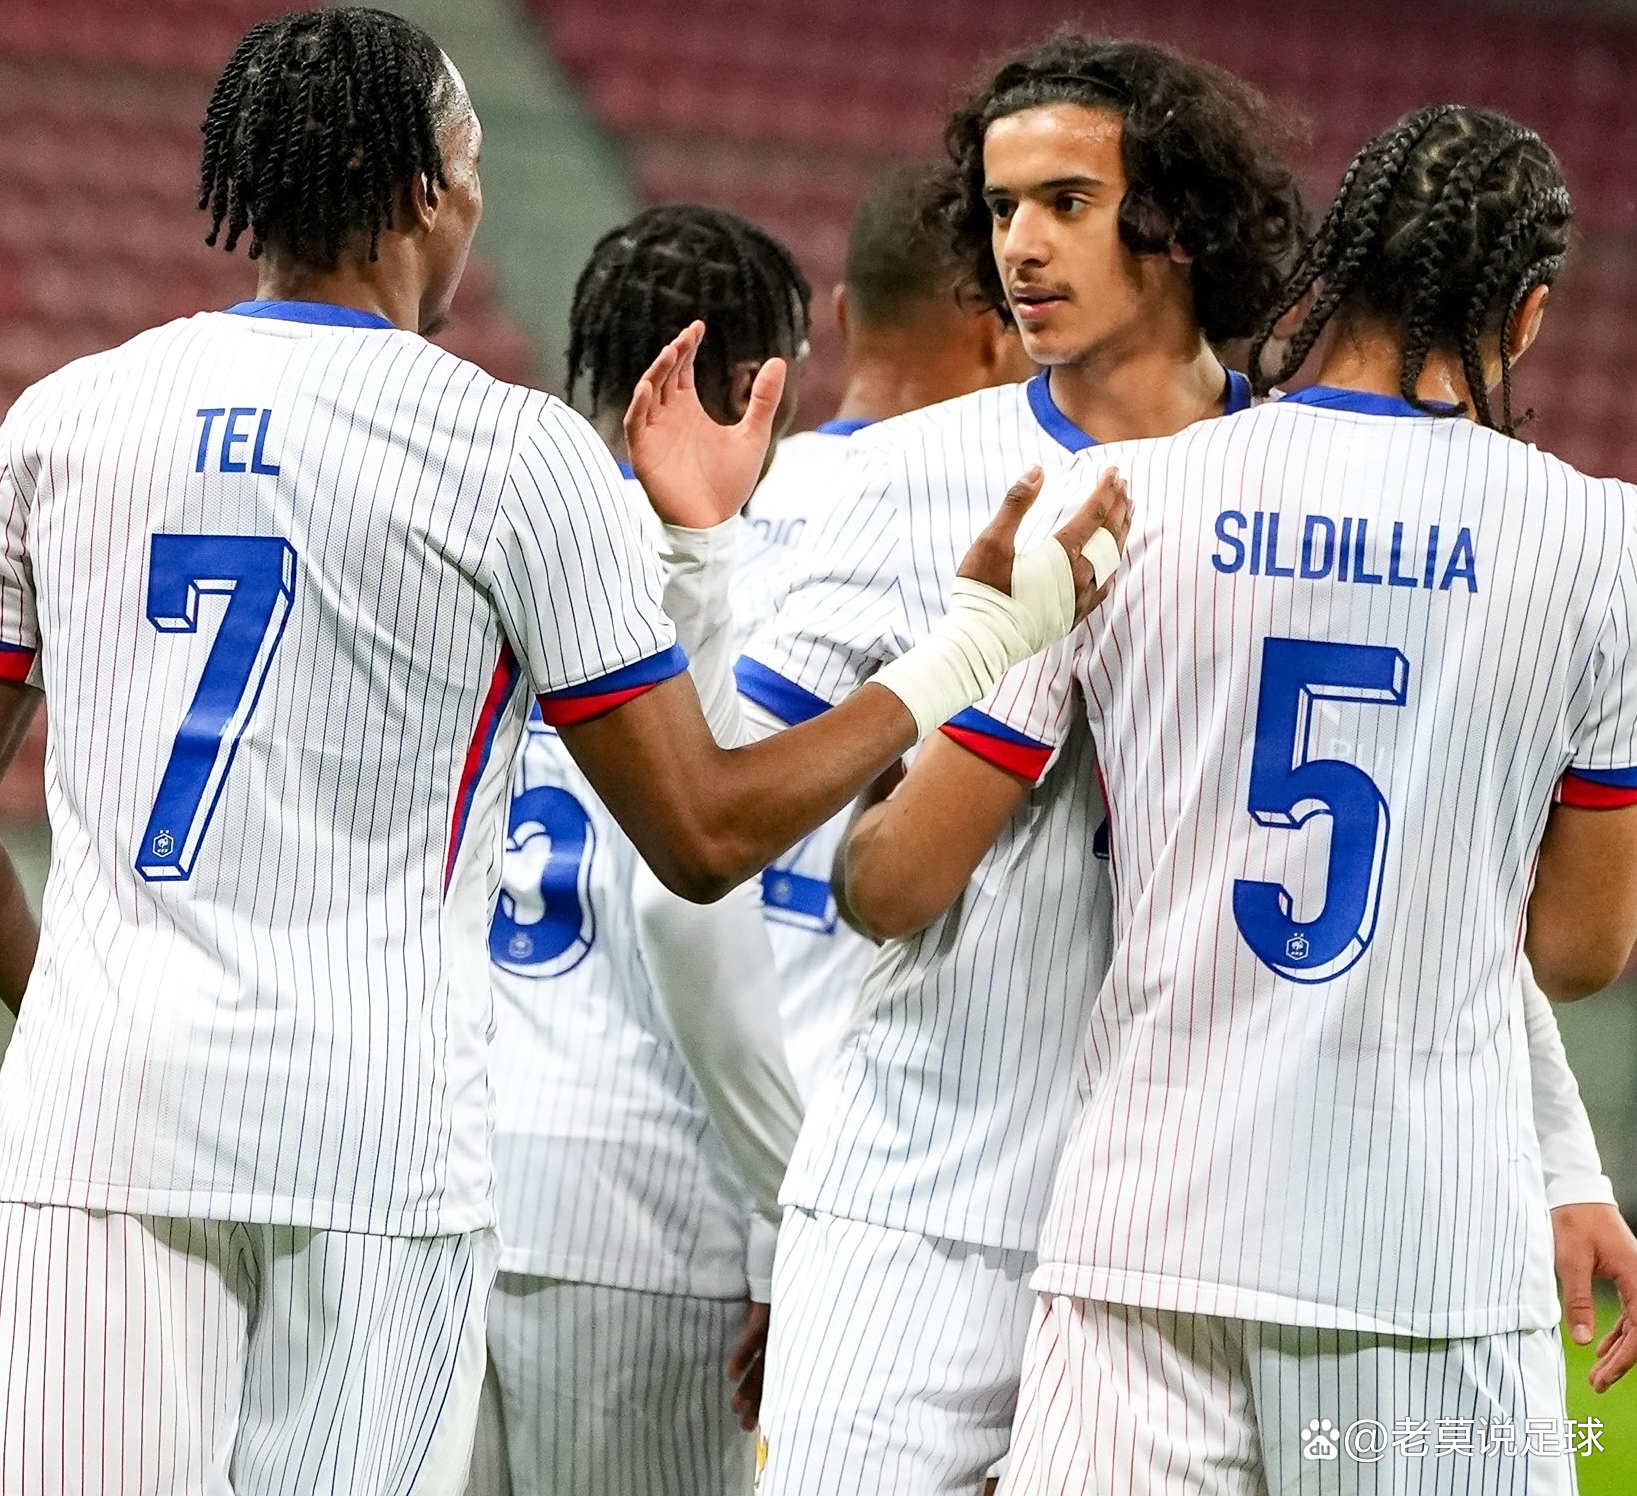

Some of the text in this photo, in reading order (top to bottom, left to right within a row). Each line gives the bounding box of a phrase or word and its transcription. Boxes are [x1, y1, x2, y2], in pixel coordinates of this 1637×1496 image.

[195, 408, 281, 476] TEL
[1212, 510, 1478, 593] SILDILLIA
[134, 534, 298, 882] 7
[1232, 636, 1411, 985] 5
